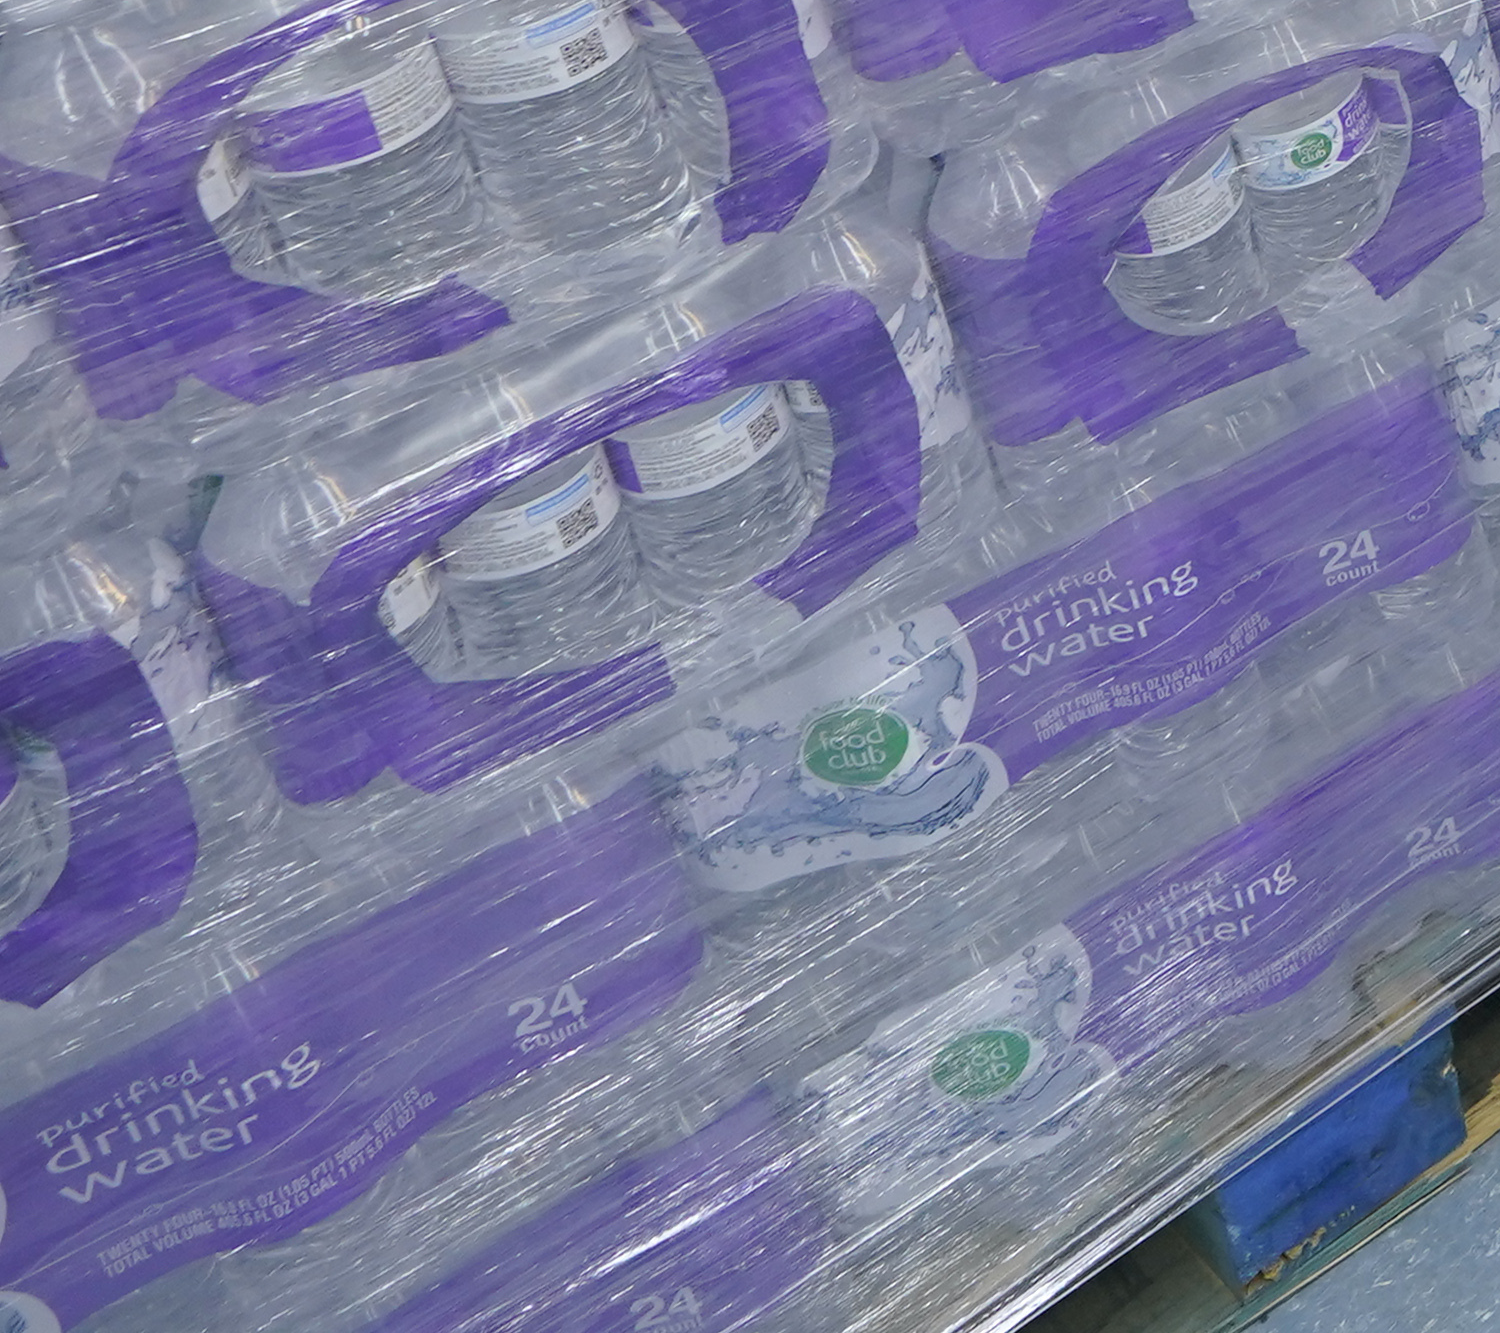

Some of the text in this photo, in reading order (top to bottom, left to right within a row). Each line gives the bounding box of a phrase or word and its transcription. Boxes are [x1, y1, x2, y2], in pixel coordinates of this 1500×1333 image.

[1317, 528, 1381, 575] 24
[1324, 556, 1381, 588] count
[998, 560, 1118, 627] purified
[1000, 559, 1200, 654] drinking
[1007, 611, 1154, 680] water
[819, 723, 886, 757] food
[826, 740, 887, 771] club
[1405, 815, 1464, 861] 24
[1114, 857, 1298, 959] drinking
[1123, 912, 1256, 983] water
[507, 983, 588, 1037] 24
[519, 1014, 590, 1055] count
[37, 1060, 205, 1146] purified
[45, 1040, 322, 1174] drinking
[57, 1111, 259, 1205] water
